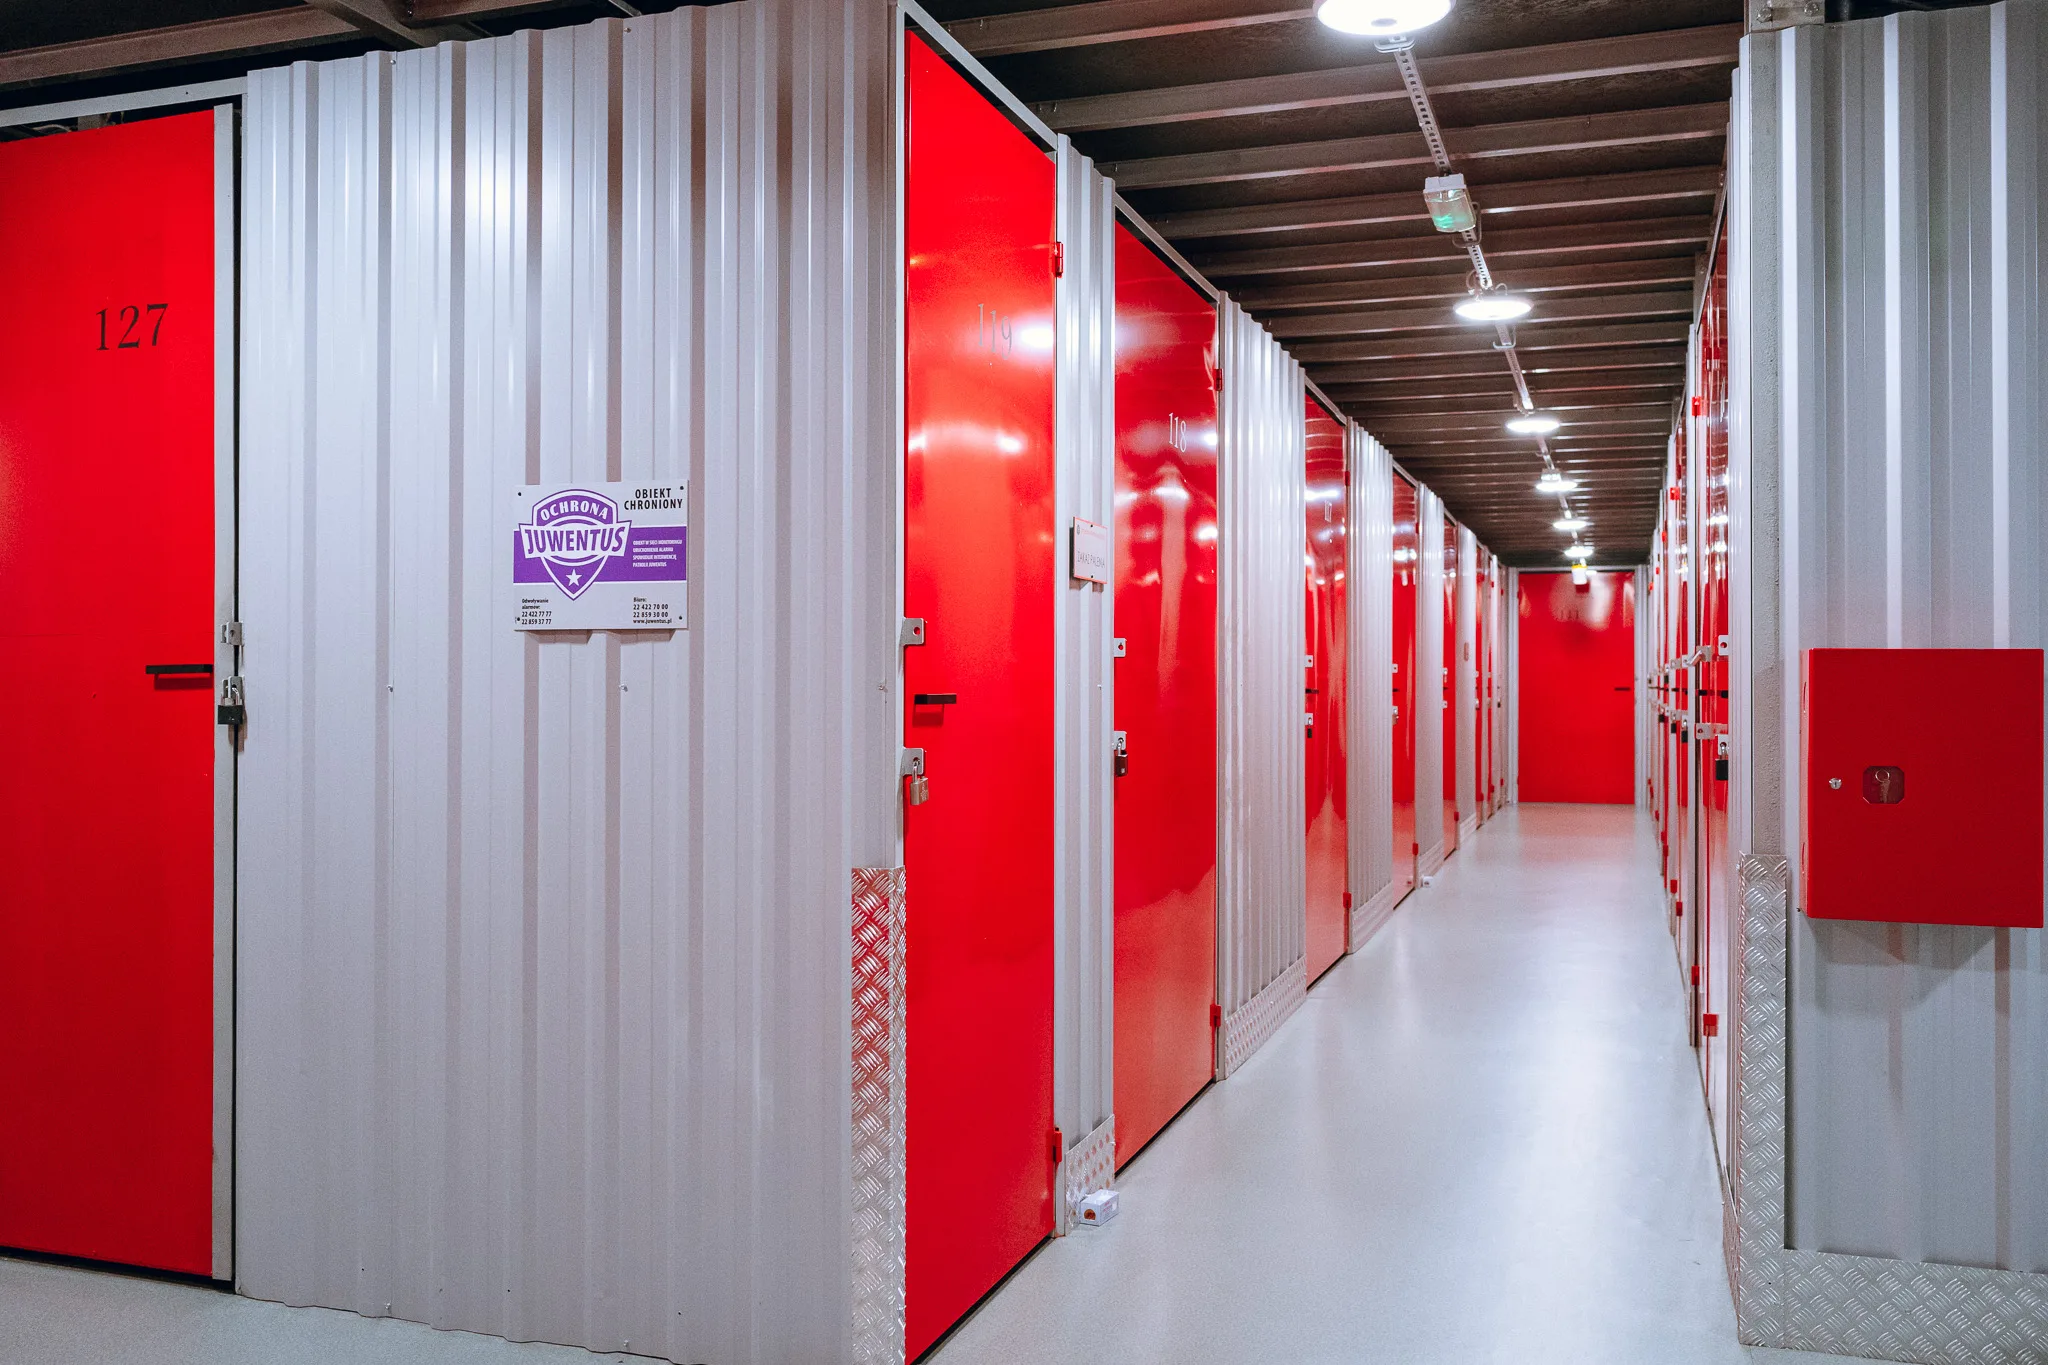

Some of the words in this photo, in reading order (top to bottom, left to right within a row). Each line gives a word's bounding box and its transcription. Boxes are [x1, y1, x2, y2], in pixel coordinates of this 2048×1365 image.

[96, 303, 168, 350] 127
[978, 303, 1012, 360] 119
[1169, 413, 1187, 452] 118
[624, 499, 683, 510] CHRONIONY
[635, 488, 671, 499] OBIEKT
[540, 500, 608, 521] OCHRONA
[525, 526, 626, 554] JUWENTUS
